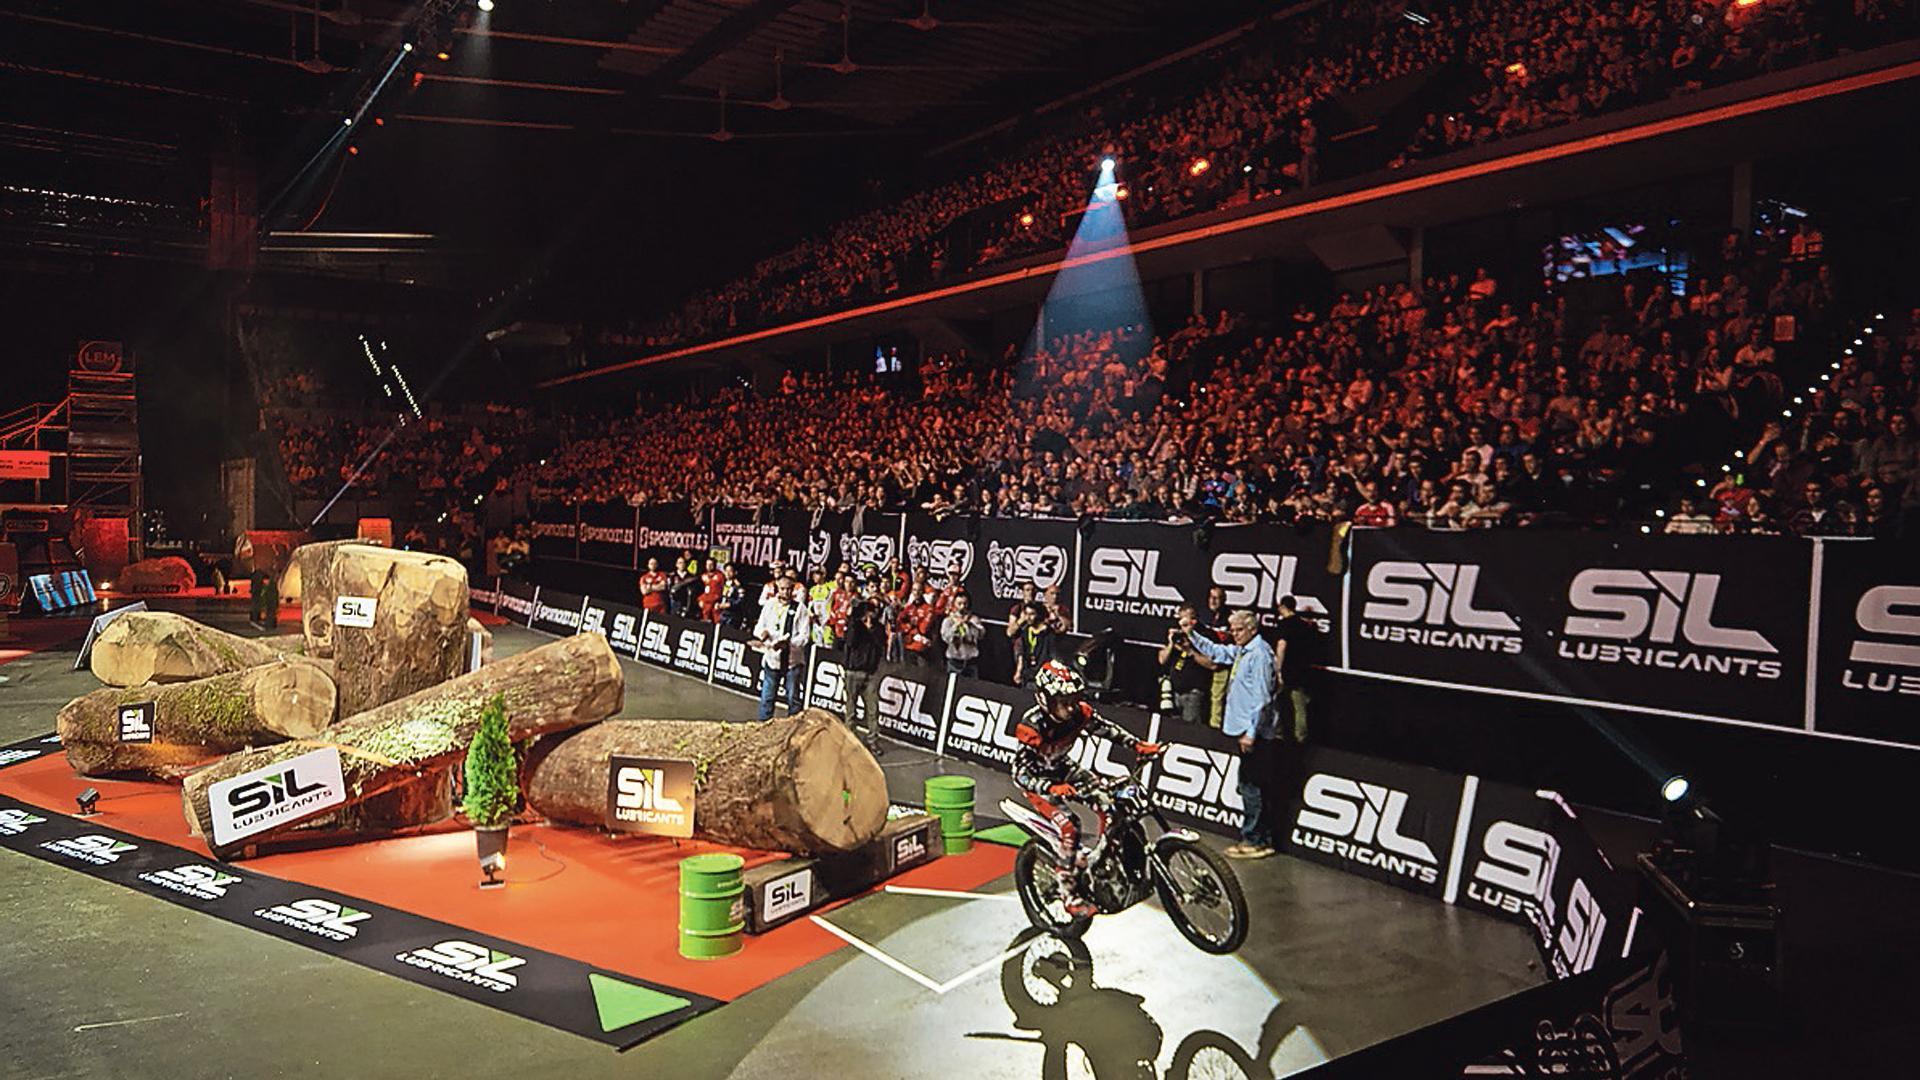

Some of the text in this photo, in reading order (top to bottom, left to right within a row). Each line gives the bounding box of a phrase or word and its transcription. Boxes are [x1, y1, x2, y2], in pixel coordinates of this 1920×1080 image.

[1088, 547, 1185, 602] SIL
[1211, 553, 1329, 615] SIL
[1363, 561, 1522, 631] SIL
[1564, 568, 1779, 654] SIL
[611, 613, 638, 645] SIL
[642, 620, 672, 655] SIL
[676, 629, 709, 665] SIL
[1360, 622, 1523, 655] LUBRICANTS
[715, 638, 752, 678] SIL
[1558, 641, 1782, 680] LUBRICANTS
[878, 675, 937, 728] SIL
[878, 715, 936, 741] UBRICANTS
[947, 735, 1016, 766] LUBRICANT
[228, 768, 328, 820] SIL
[232, 789, 333, 831] LUBRICANTS
[616, 766, 685, 812] SIL
[1152, 791, 1246, 829] LUBRICAN
[1296, 773, 1439, 865] SIL
[1291, 828, 1440, 884] LUBRICANTS
